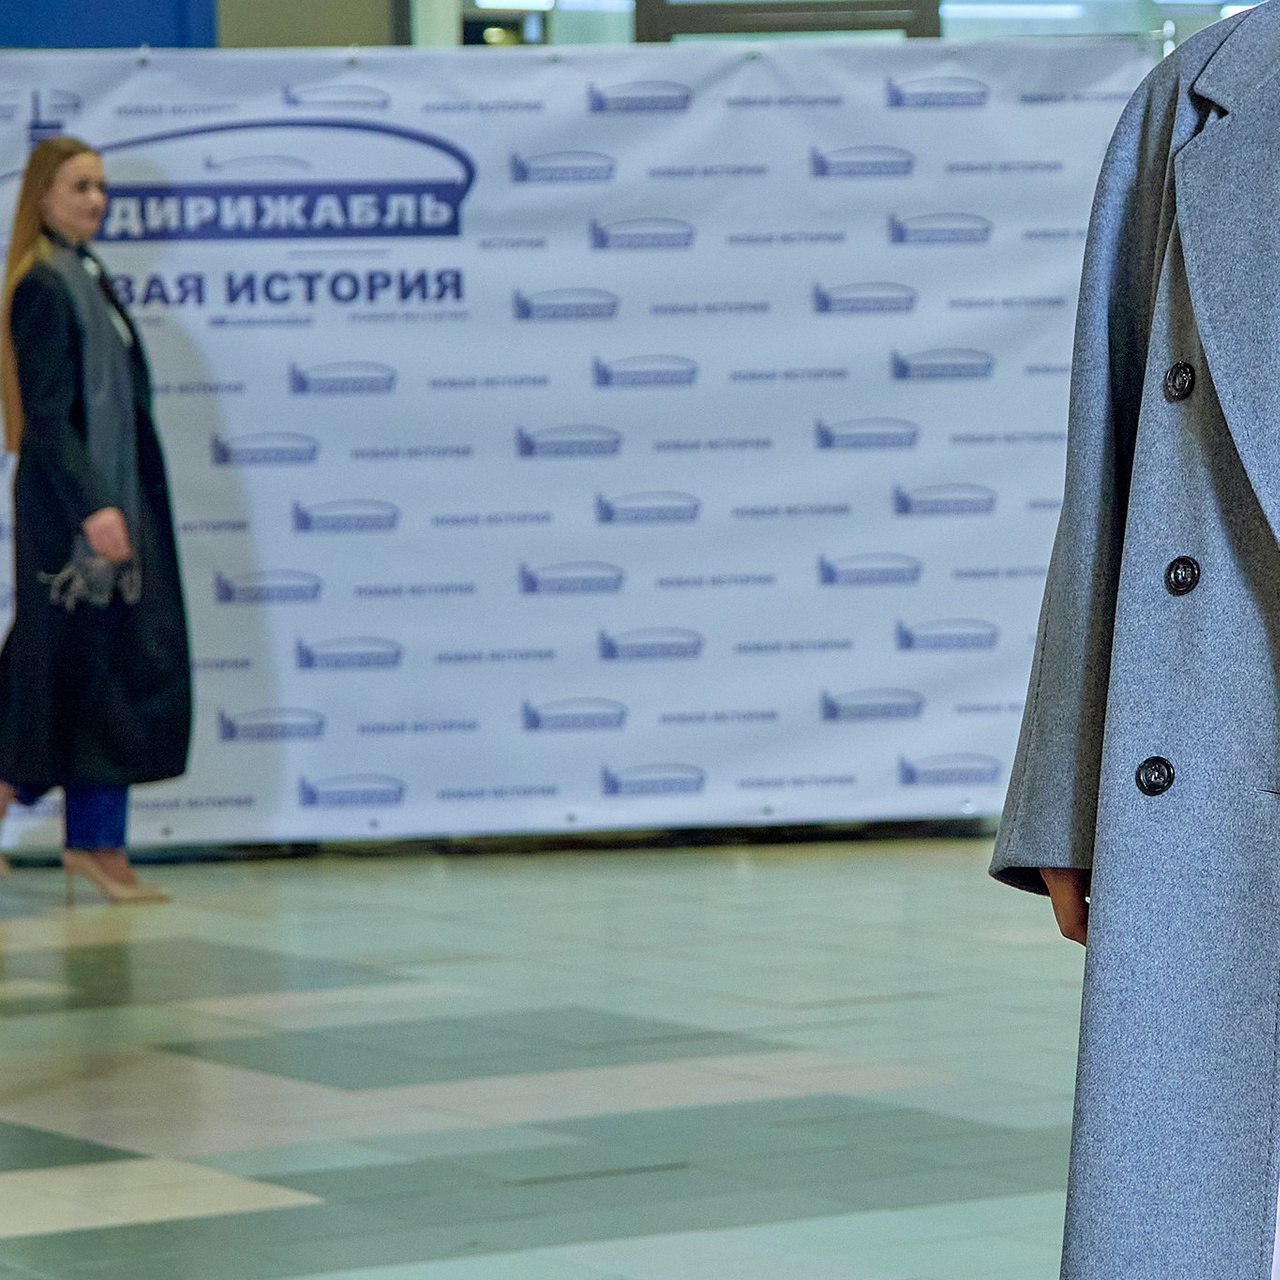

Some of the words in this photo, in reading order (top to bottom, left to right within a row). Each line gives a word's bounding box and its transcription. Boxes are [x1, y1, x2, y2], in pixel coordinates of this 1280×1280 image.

[106, 192, 456, 238] ДИРИЖАБЛЬ
[114, 272, 205, 306] ВАЯ
[225, 268, 465, 305] ИСТОРИЯ
